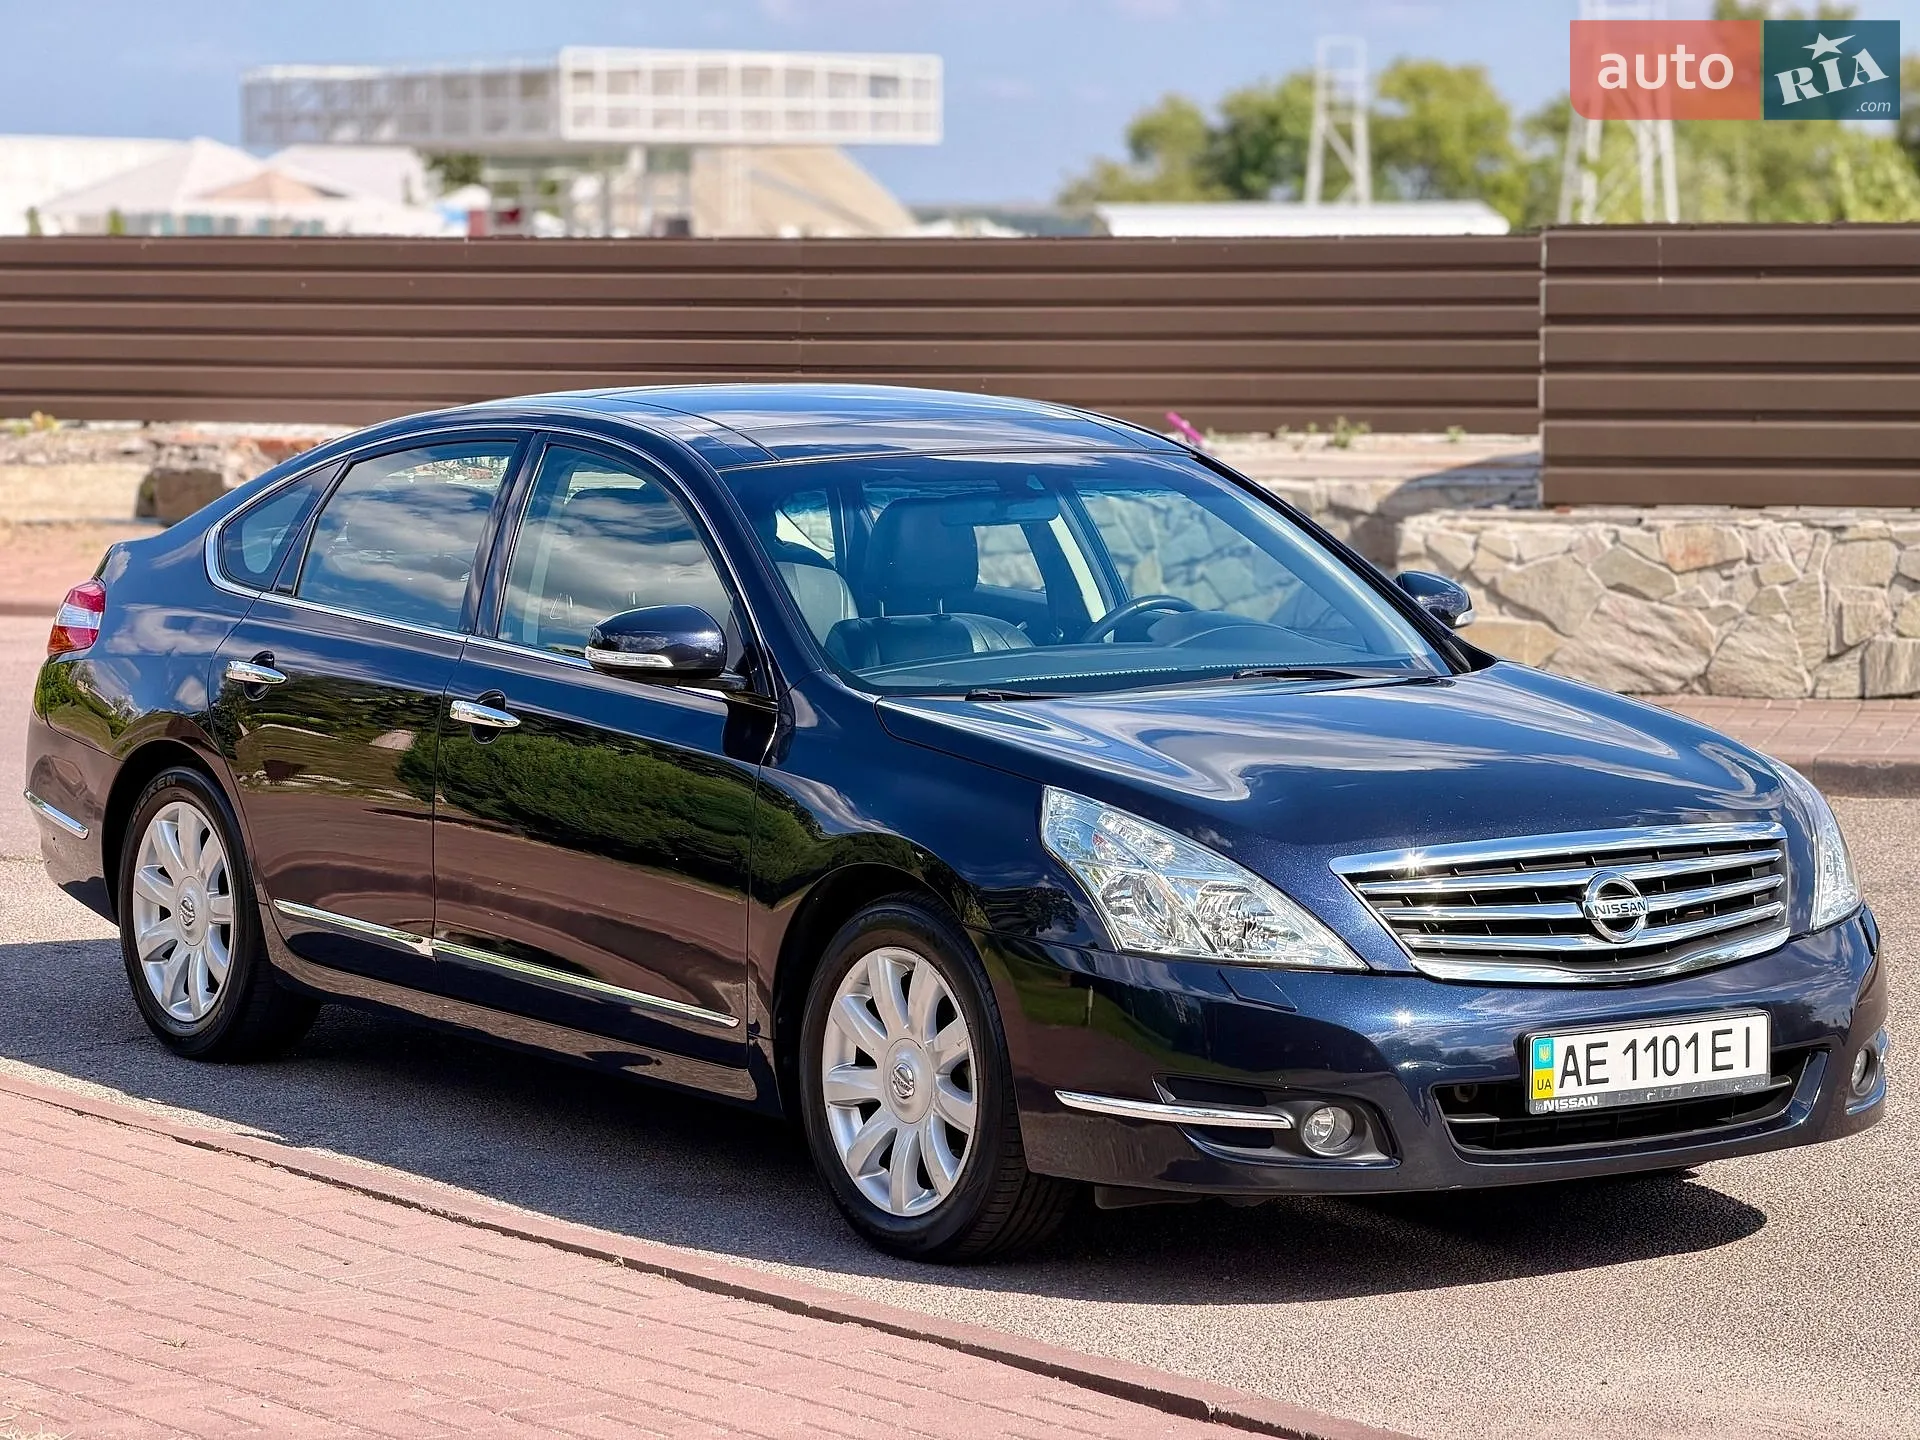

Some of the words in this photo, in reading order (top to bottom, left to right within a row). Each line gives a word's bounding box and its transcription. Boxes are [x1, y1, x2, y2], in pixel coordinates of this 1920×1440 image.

[1594, 901, 1646, 915] NISSAN
[1559, 1041, 1609, 1088] AE
[1622, 1032, 1699, 1081] 1101
[1711, 1026, 1750, 1071] EI
[1537, 1078, 1552, 1091] UA
[1544, 1096, 1598, 1111] NISSAN
